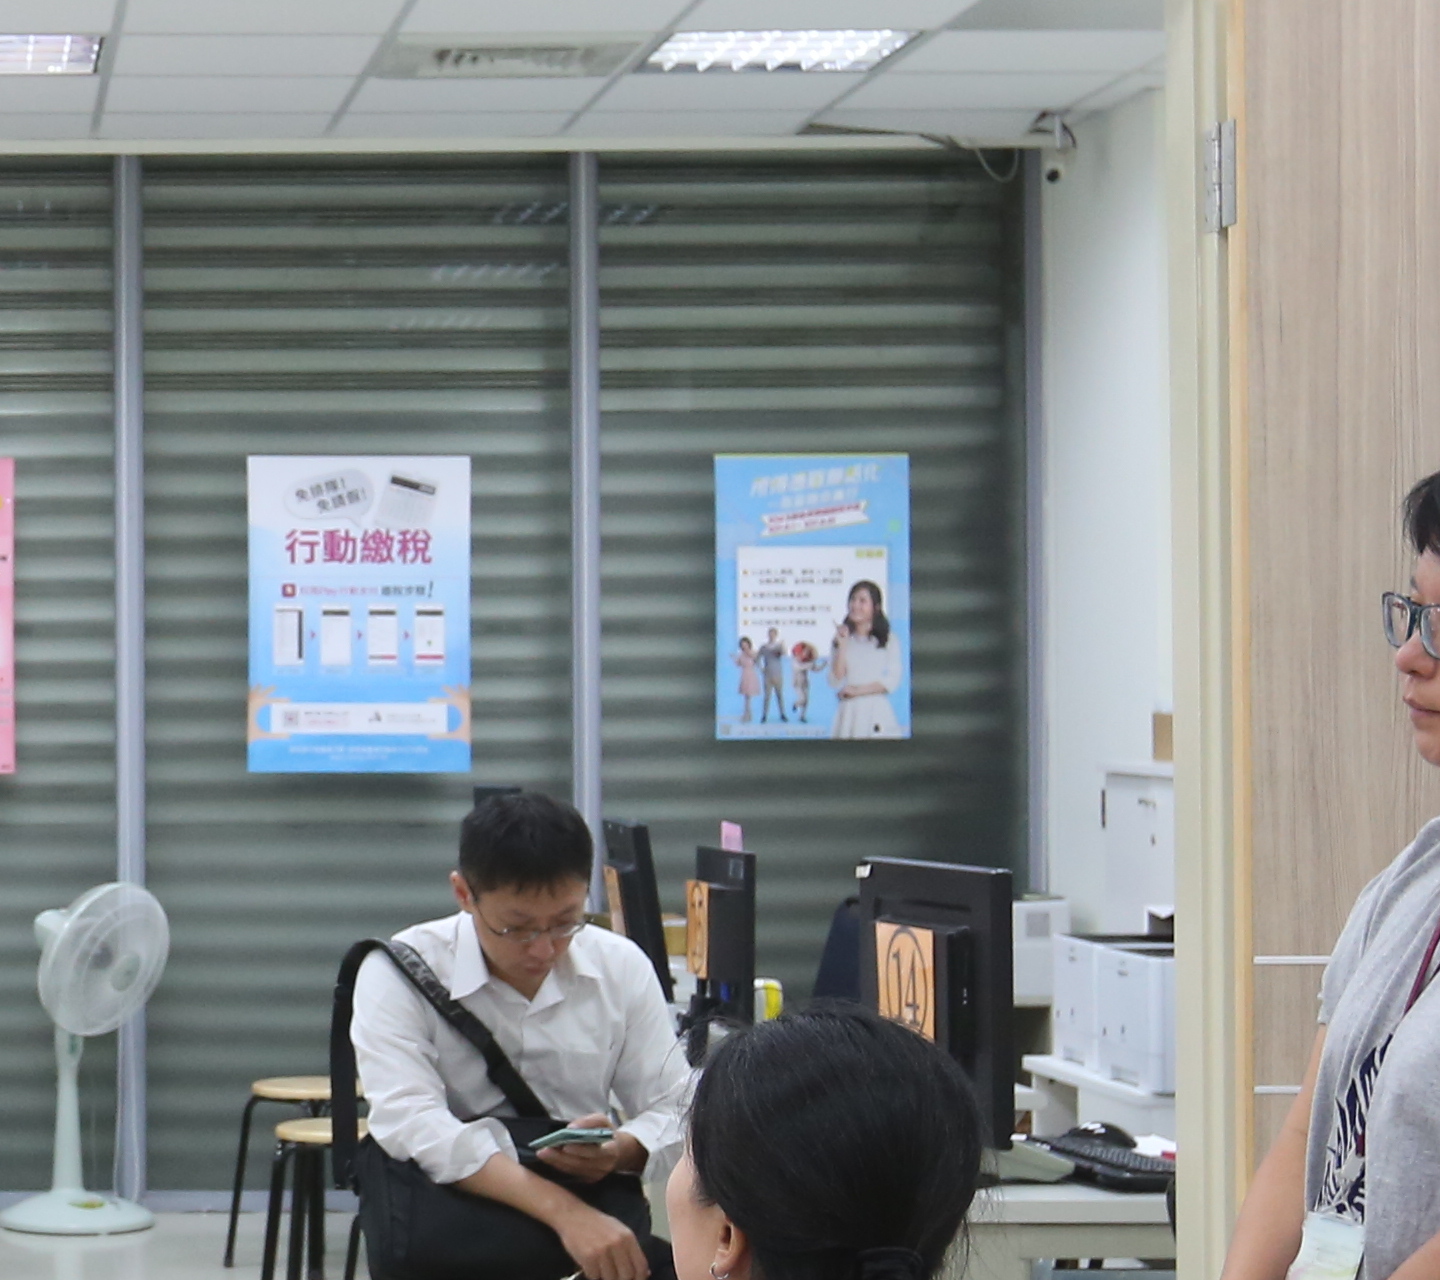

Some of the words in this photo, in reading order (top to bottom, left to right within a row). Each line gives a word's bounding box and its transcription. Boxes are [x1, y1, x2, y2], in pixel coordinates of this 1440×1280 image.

[285, 529, 432, 564] 行動繳稅
[891, 949, 920, 1024] 14
